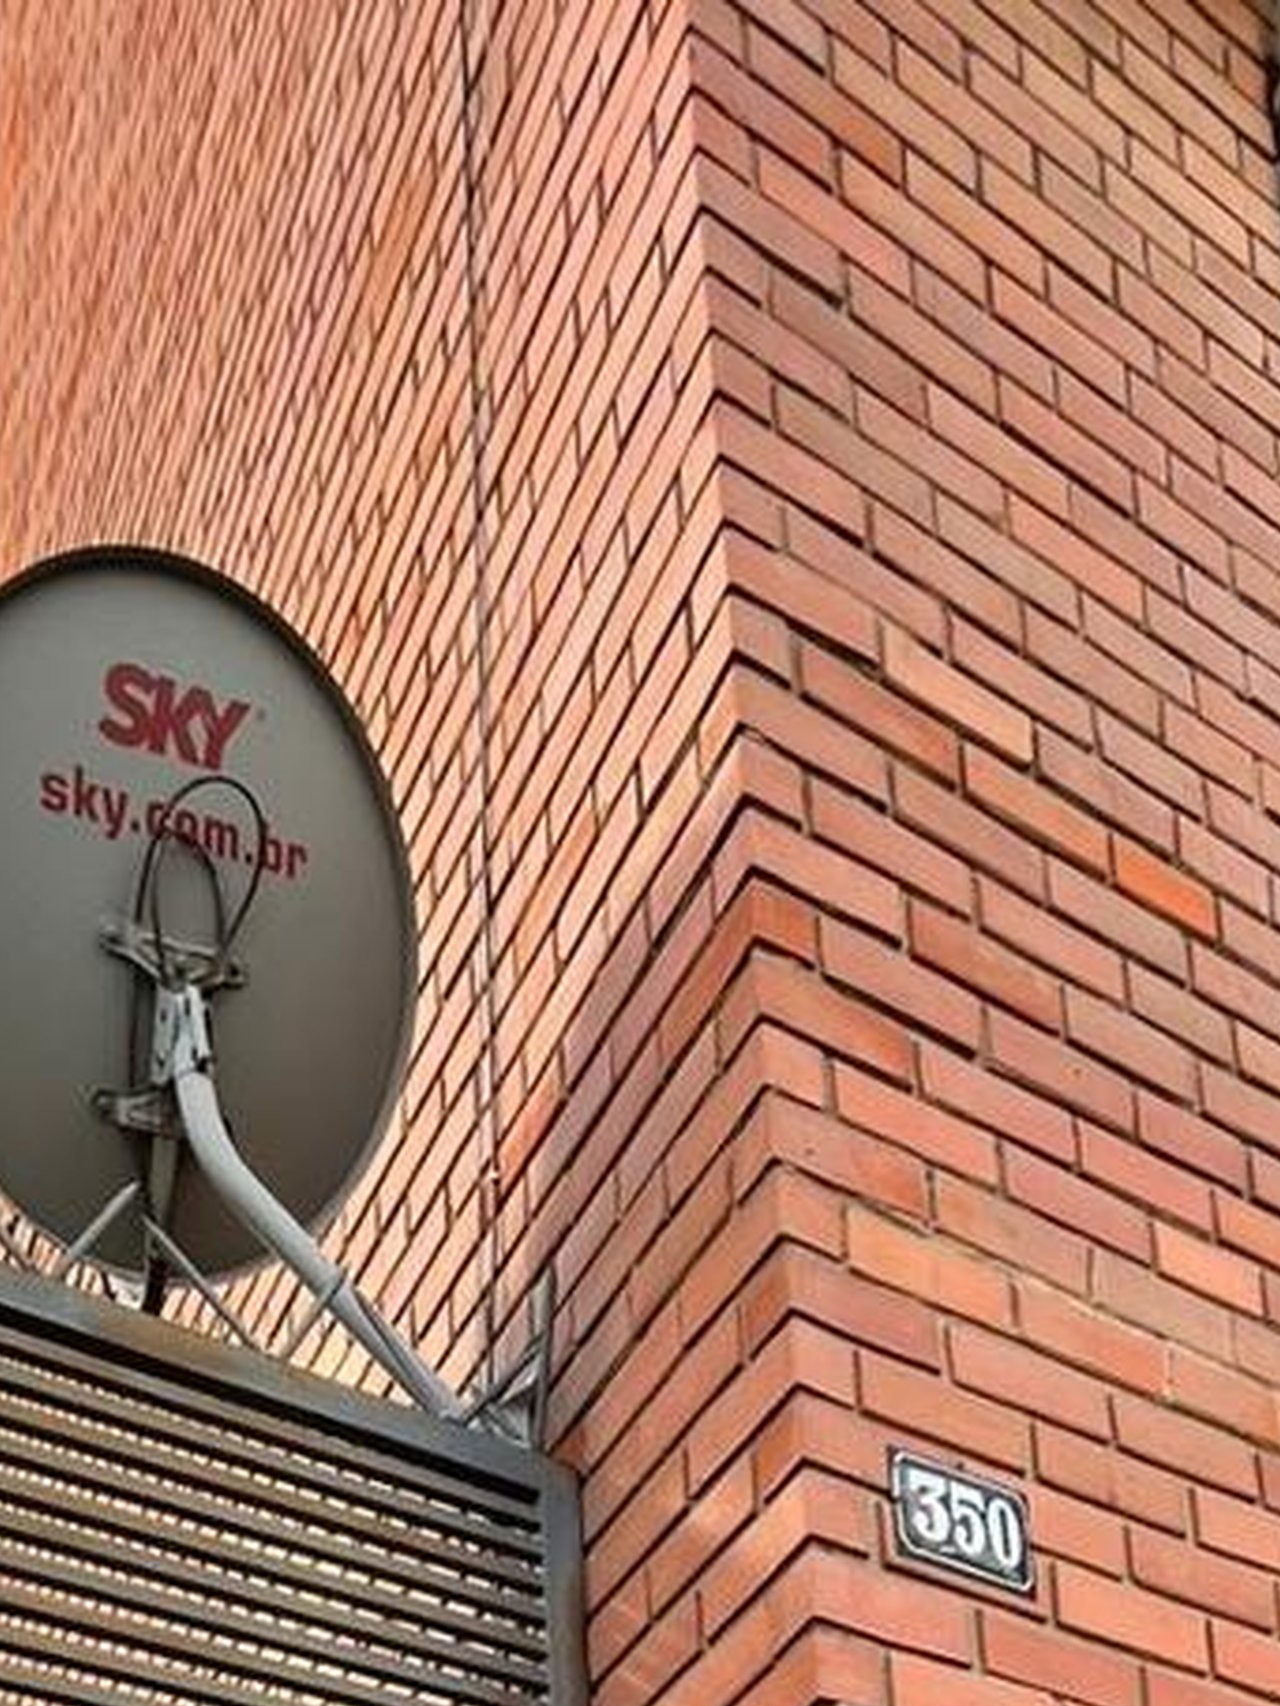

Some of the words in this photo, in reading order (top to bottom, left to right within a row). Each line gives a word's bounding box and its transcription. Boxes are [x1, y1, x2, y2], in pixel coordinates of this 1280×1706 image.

[99, 662, 251, 770] SKY
[39, 766, 308, 878] sky.com.br
[909, 1468, 1022, 1569] 350
